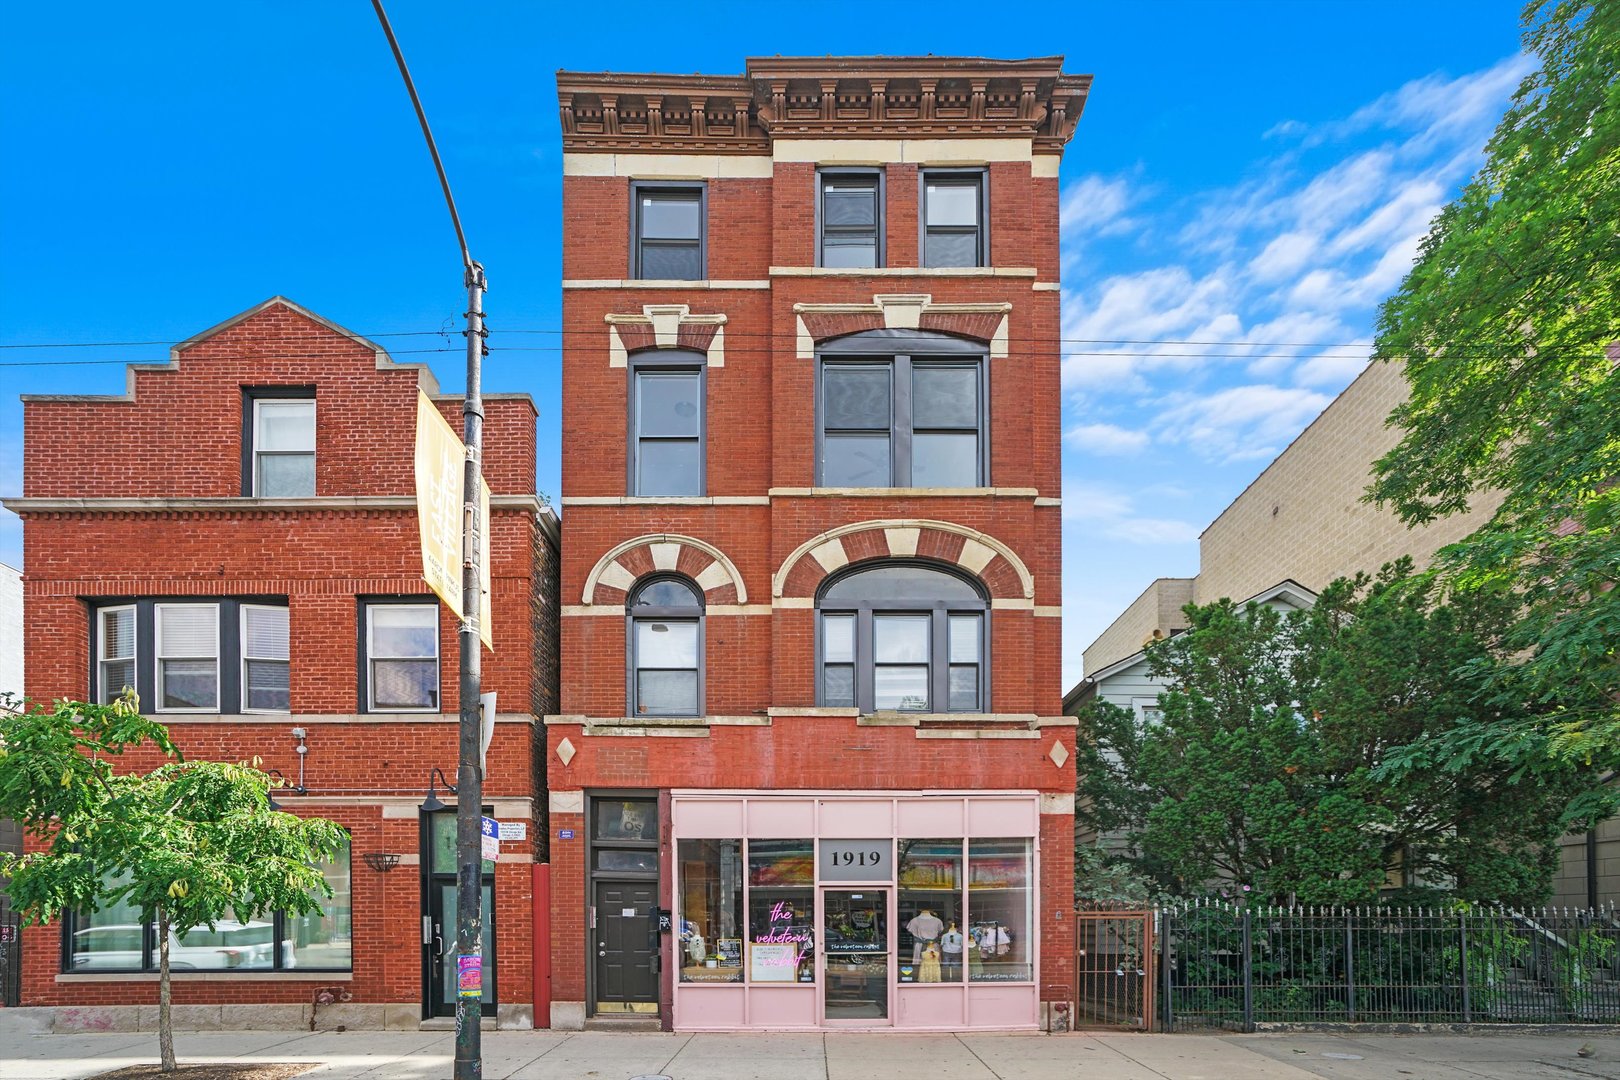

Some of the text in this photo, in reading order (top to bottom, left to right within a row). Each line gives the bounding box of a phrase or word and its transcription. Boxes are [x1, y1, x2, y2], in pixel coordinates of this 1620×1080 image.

[430, 473, 443, 547] EAST
[443, 462, 457, 556] VILLAGE
[832, 851, 881, 866] 1919
[770, 901, 792, 922] the
